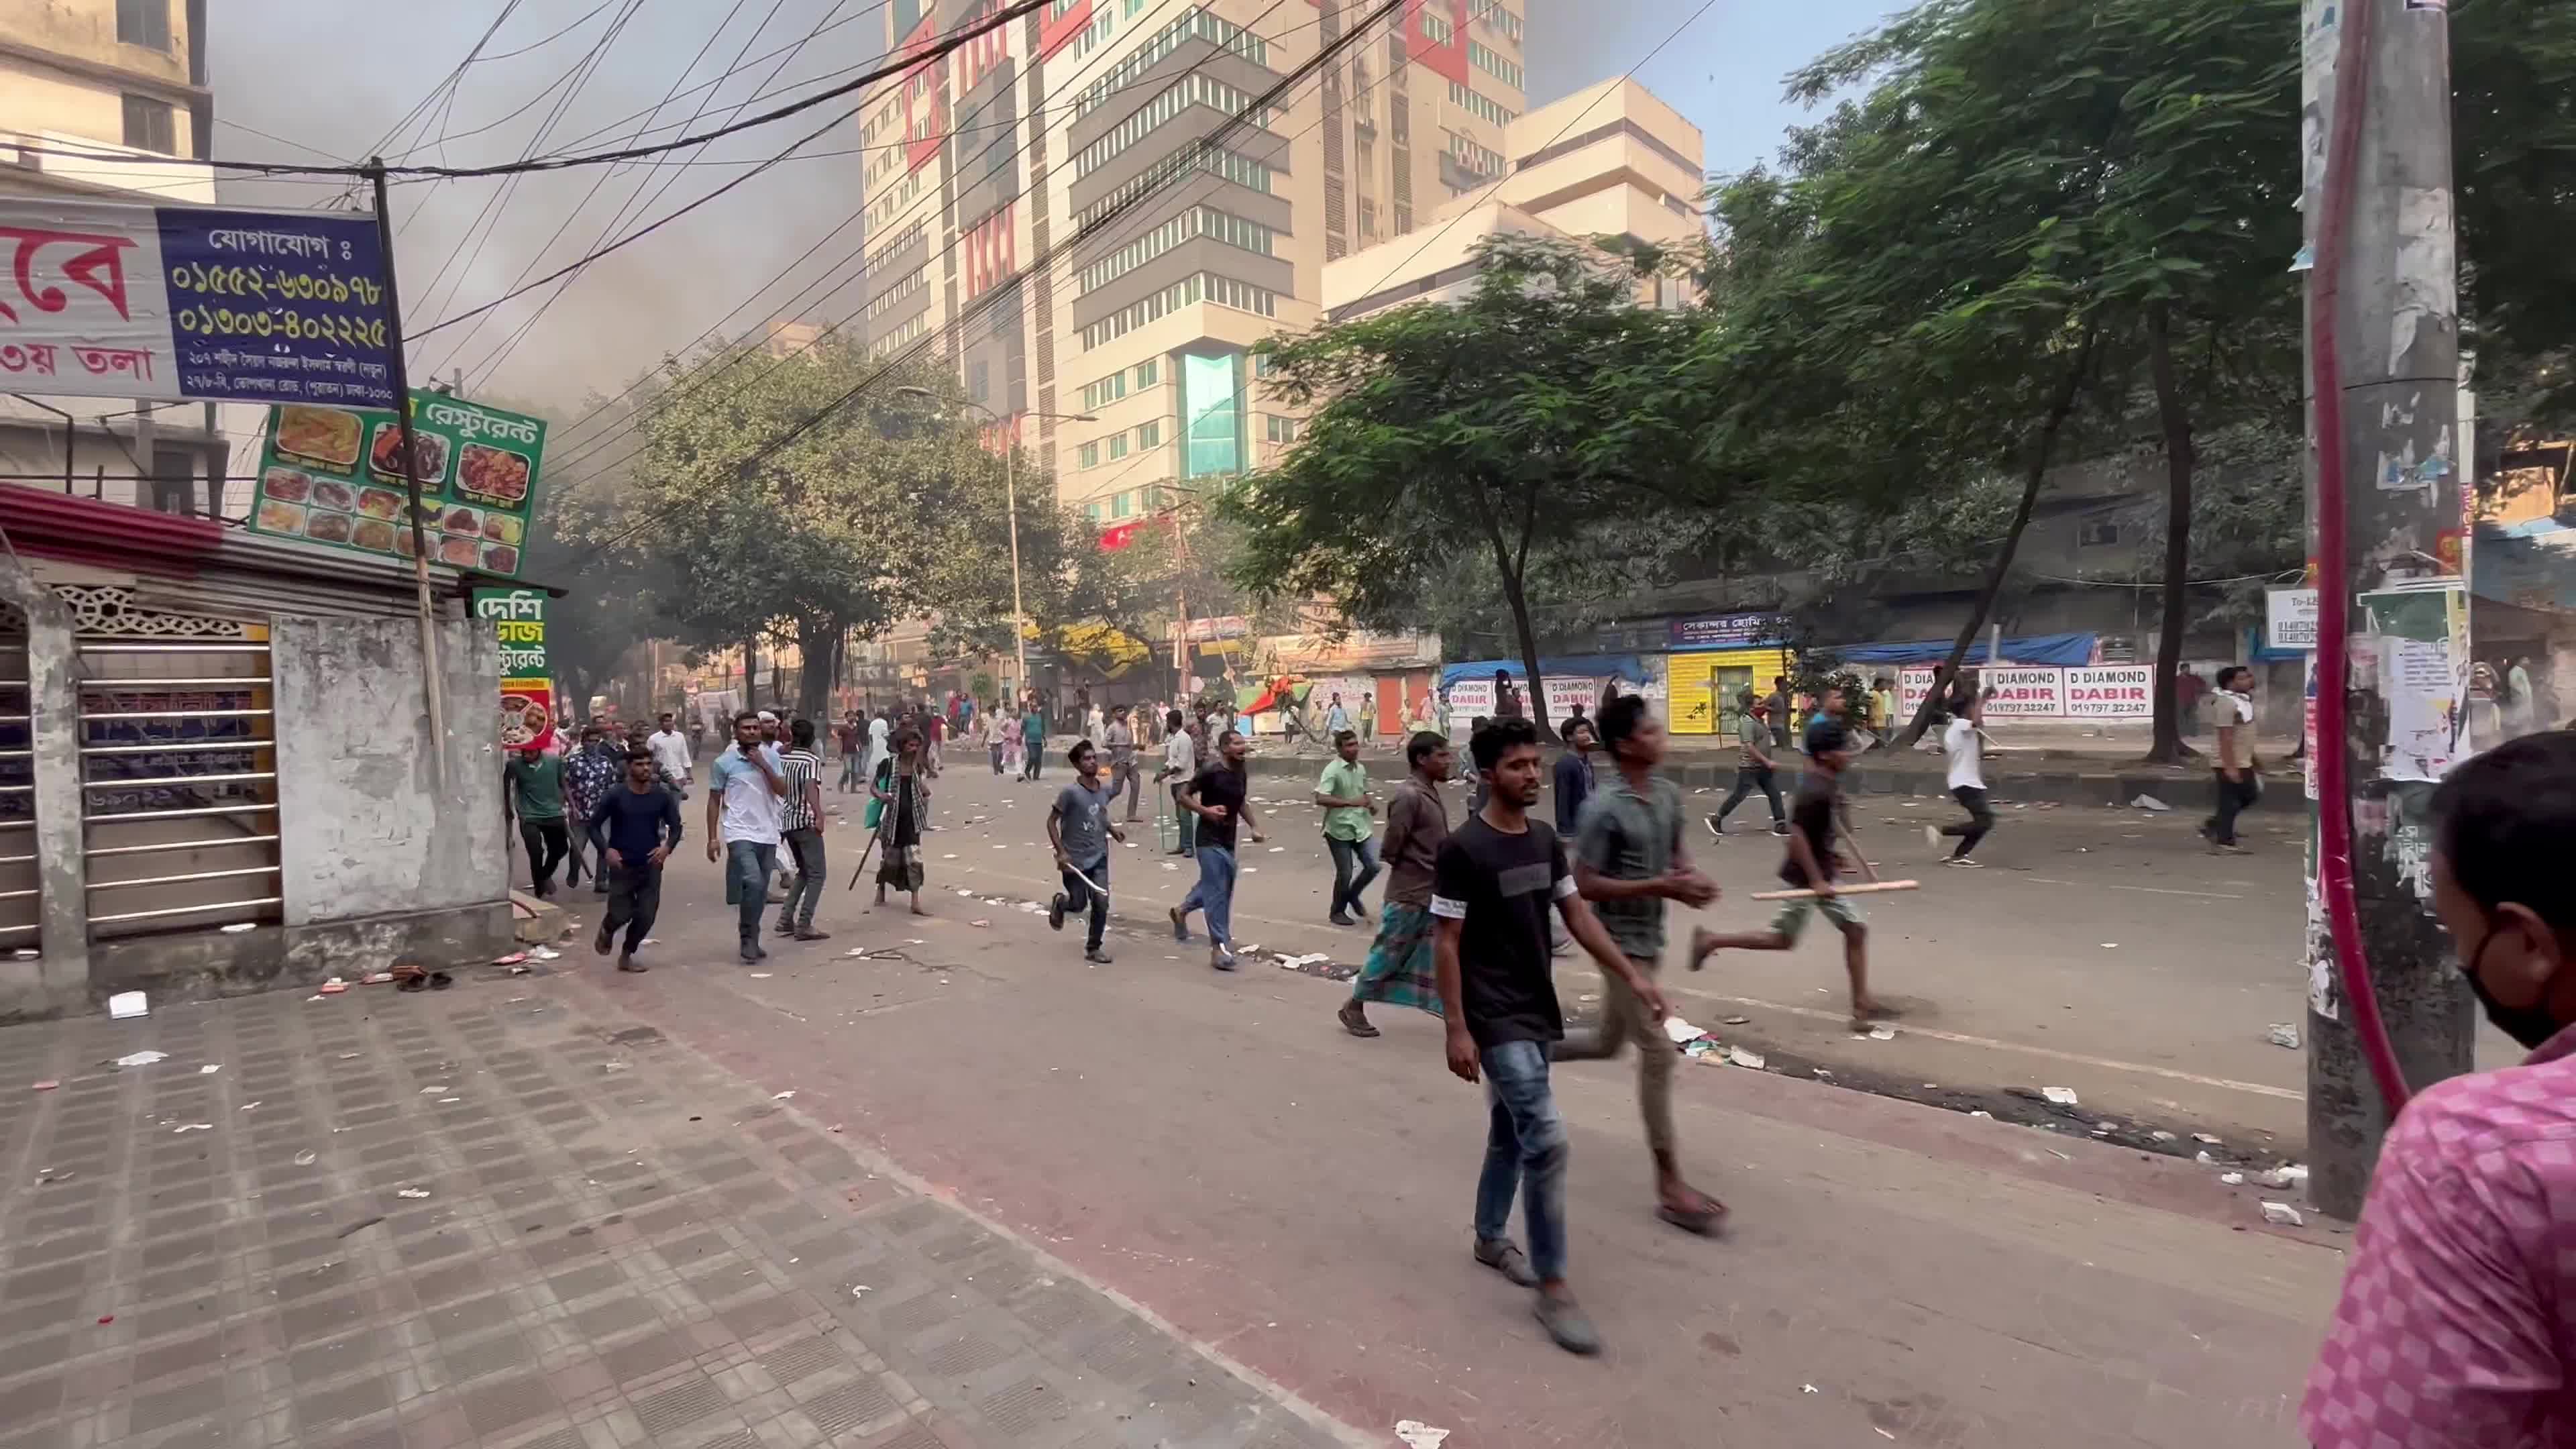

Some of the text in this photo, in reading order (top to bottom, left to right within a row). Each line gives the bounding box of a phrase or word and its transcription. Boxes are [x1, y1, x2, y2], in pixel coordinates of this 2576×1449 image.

[209, 229, 331, 259] যোগাযোগ
[0, 227, 140, 323] বে
[172, 262, 382, 307] ০১৫৫২-৬৩০৯৭৮
[179, 304, 386, 350] ০১৩০৩-৪০২২২৫
[70, 345, 156, 382] তলা
[426, 403, 539, 444] রেস্টুরেন্ট
[478, 590, 543, 620] দেশি
[1997, 673, 2055, 684] DIAMOND
[2071, 672, 2146, 684] D DIAMOND
[2071, 688, 2145, 700] DABIR
[2072, 703, 2146, 712] 019797 32247
